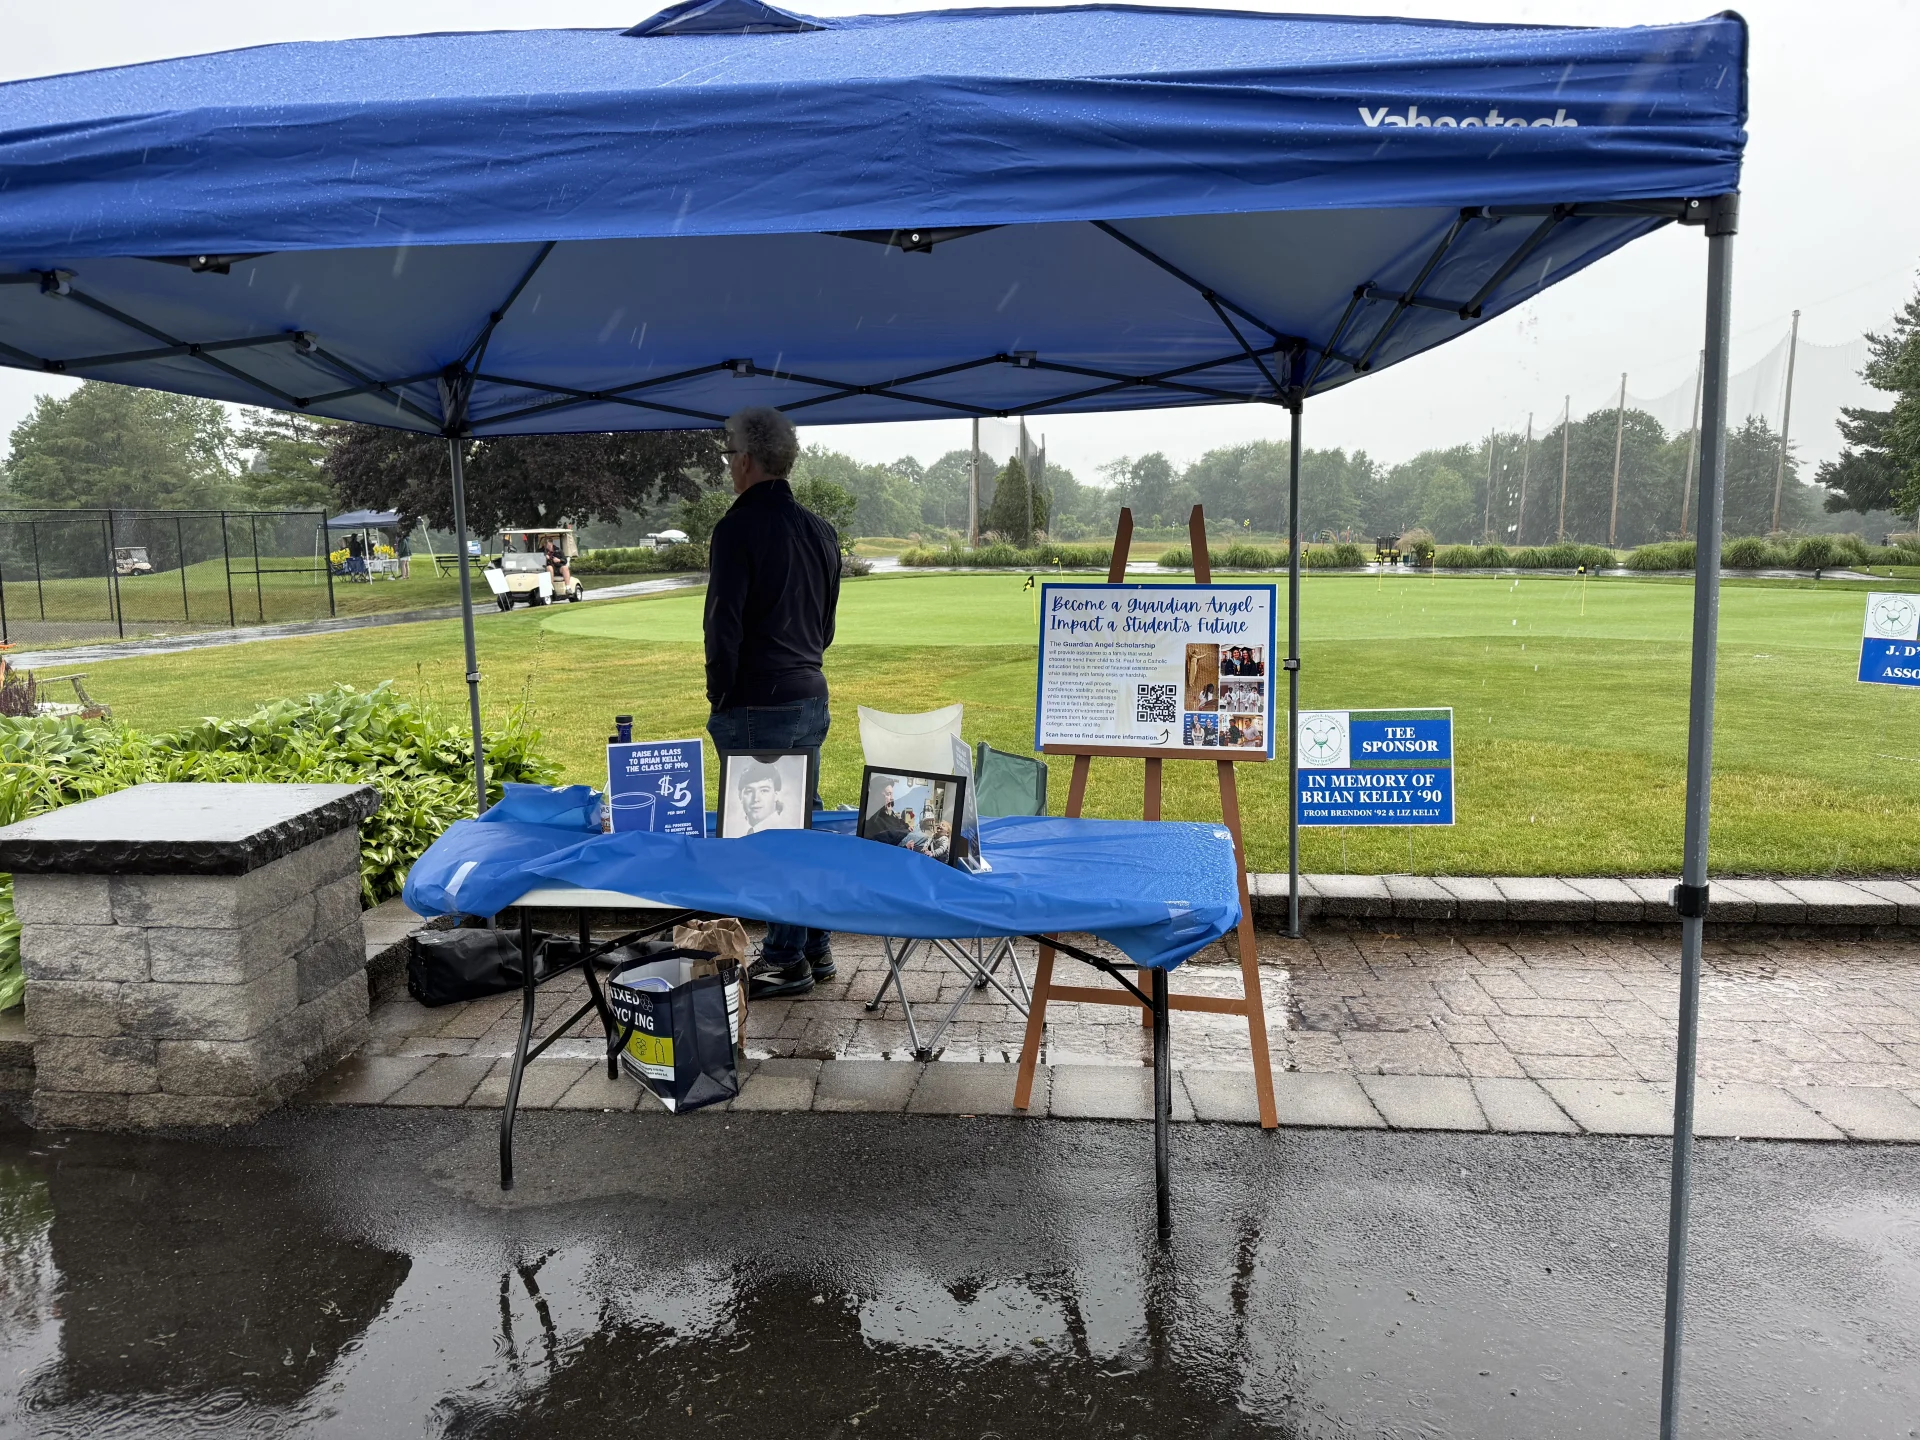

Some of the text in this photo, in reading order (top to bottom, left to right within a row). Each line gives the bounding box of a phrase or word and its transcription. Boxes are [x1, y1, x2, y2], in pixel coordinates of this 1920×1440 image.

[1052, 596, 1107, 611] Become
[1111, 600, 1122, 612] a
[1128, 596, 1202, 613] Guardian
[1205, 595, 1254, 616] Angel
[1050, 615, 1104, 634] Impact
[1107, 620, 1117, 631] a
[1197, 618, 1248, 634] Future
[1885, 645, 1900, 656] J.
[1385, 727, 1416, 739] TEE
[1362, 740, 1439, 752] SPONSOR
[632, 750, 652, 758] RAISE
[640, 757, 660, 765] BRIAN
[662, 755, 682, 763] KELLY
[626, 765, 639, 773] THE
[641, 763, 662, 772] CLASS
[1307, 774, 1435, 788] IN MEMORY OF
[655, 774, 692, 807] $5
[1301, 790, 1354, 804] BRIAN
[1359, 790, 1414, 803] KELLY
[1304, 809, 1329, 817] FROM
[1331, 809, 1372, 817] BRENDON
